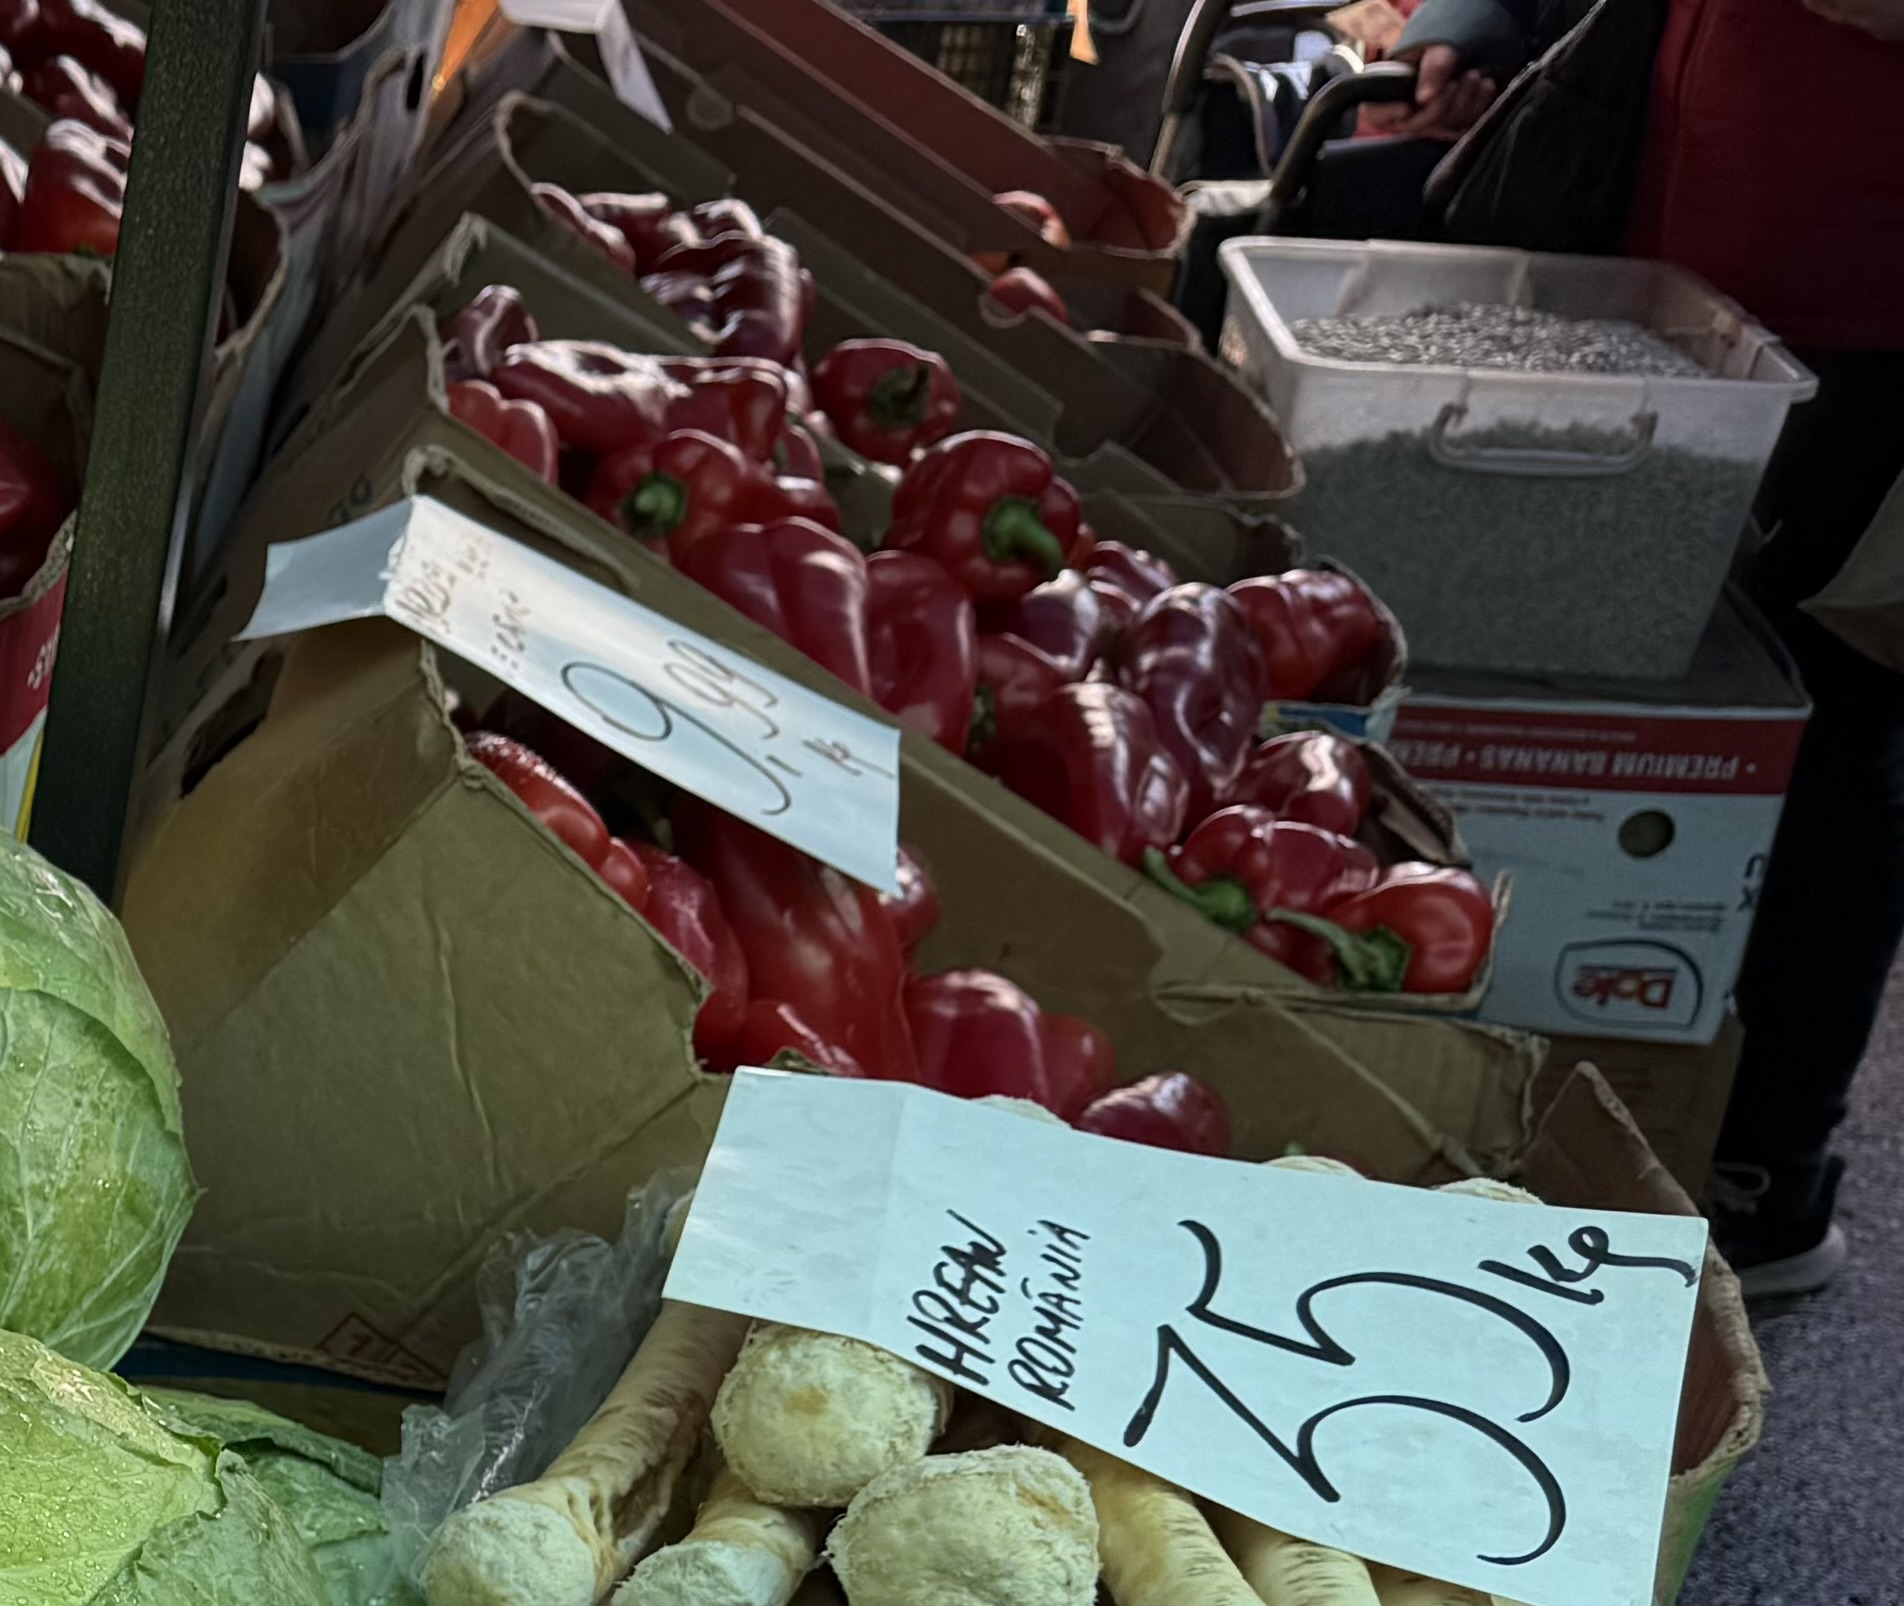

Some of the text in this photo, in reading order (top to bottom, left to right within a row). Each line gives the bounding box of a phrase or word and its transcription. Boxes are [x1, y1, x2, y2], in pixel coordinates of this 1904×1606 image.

[1479, 747, 1606, 778] BANANAS
[1610, 750, 1739, 781] PREMIUM
[1573, 964, 1677, 1010] Dole
[1122, 1218, 1571, 1567] 35
